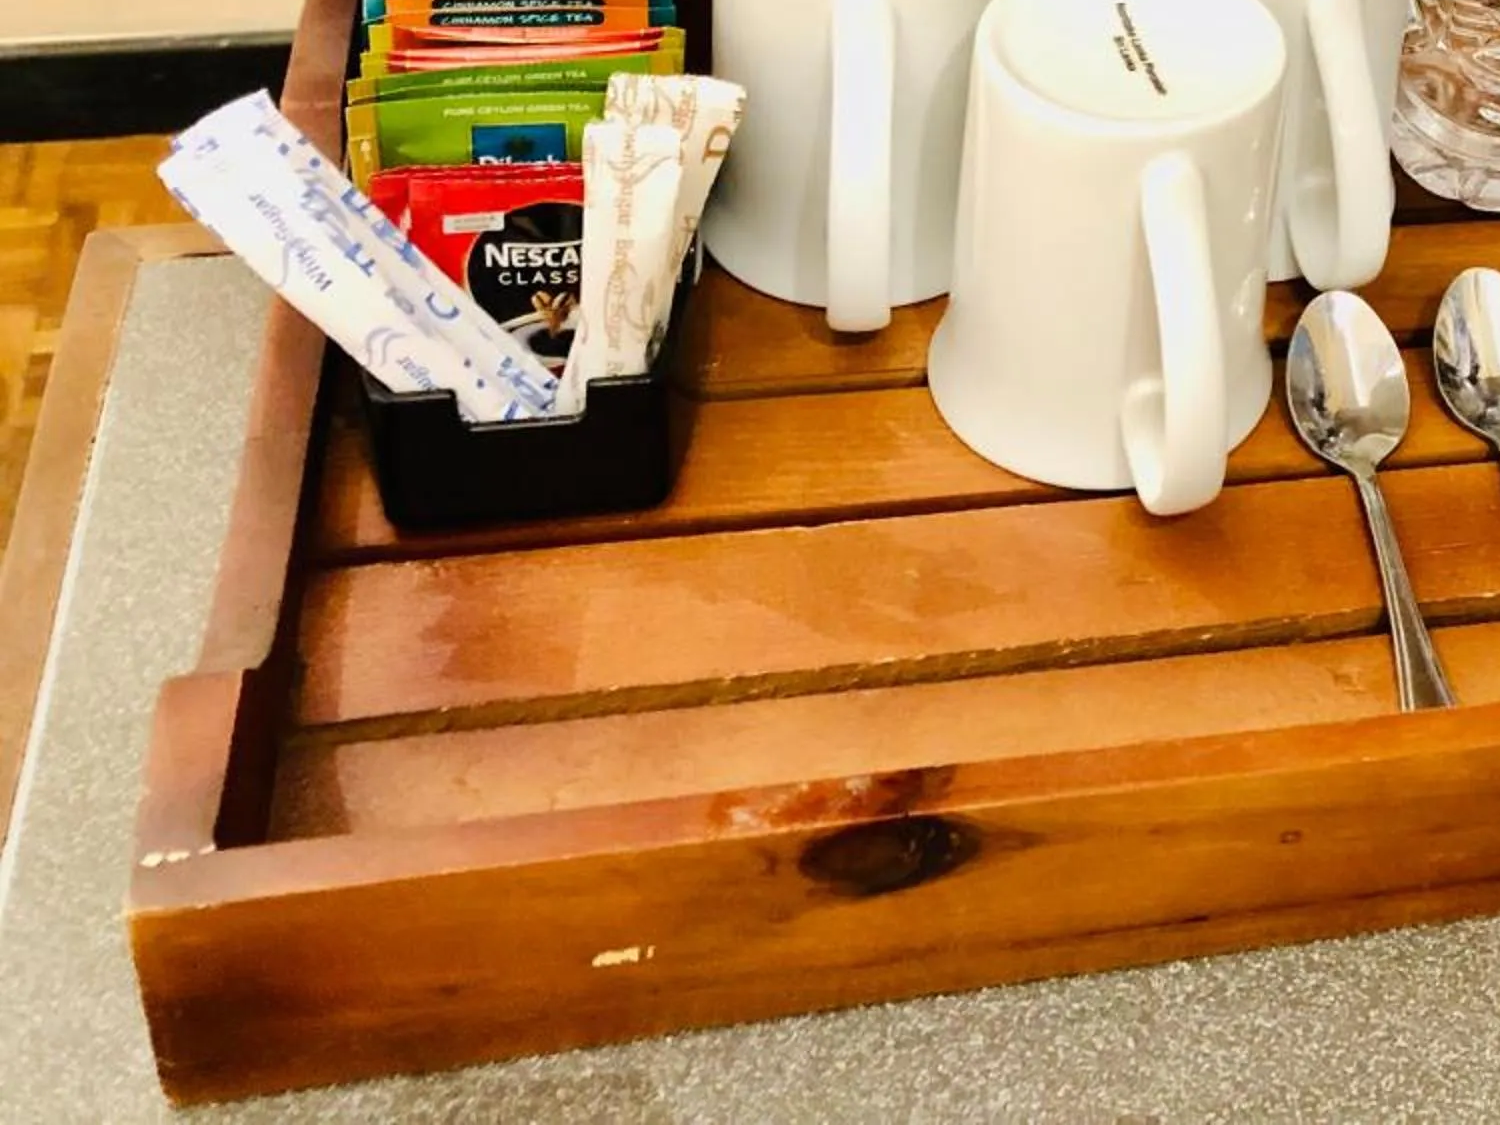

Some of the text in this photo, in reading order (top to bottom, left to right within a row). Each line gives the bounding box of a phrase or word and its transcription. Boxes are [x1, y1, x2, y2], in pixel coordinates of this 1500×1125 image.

[566, 12, 593, 22] TEA
[484, 241, 581, 268] NESCA
[498, 271, 579, 286] CLASS
[397, 355, 439, 390] ugar
